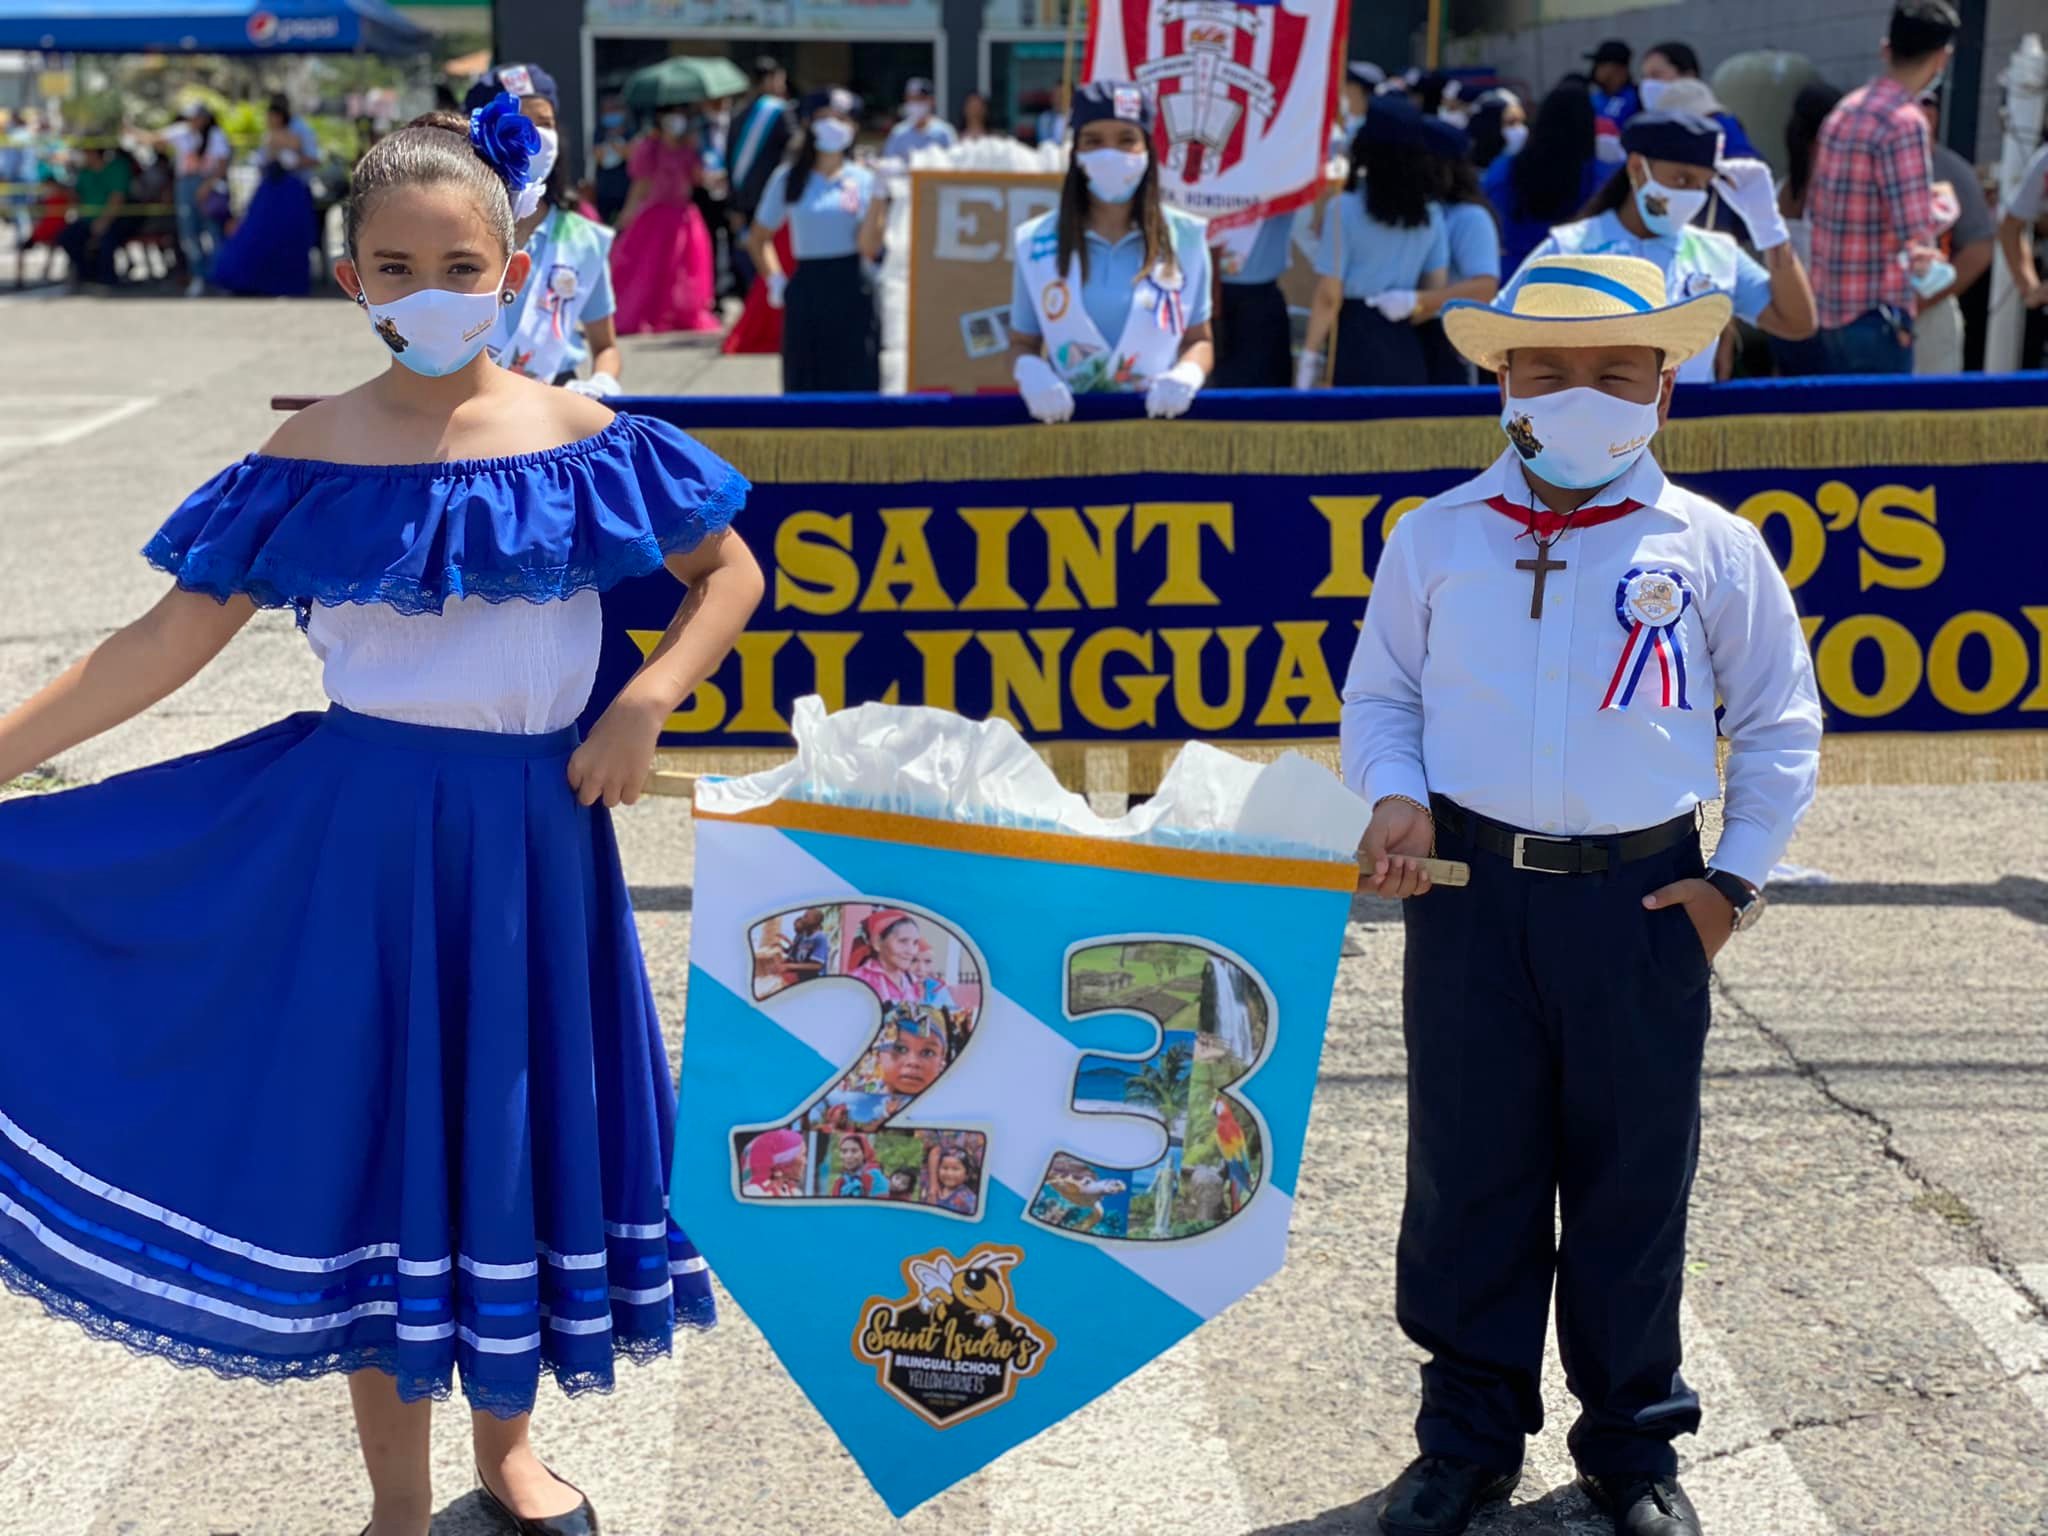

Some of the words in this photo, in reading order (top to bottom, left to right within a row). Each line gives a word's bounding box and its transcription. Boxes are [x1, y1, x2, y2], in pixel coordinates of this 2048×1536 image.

[775, 501, 1235, 615] SAINT
[866, 1310, 941, 1351] Saint
[944, 1317, 1038, 1368] Isidro's
[895, 1354, 952, 1371] BILINGUAL
[954, 1360, 1002, 1377] SCHOOL
